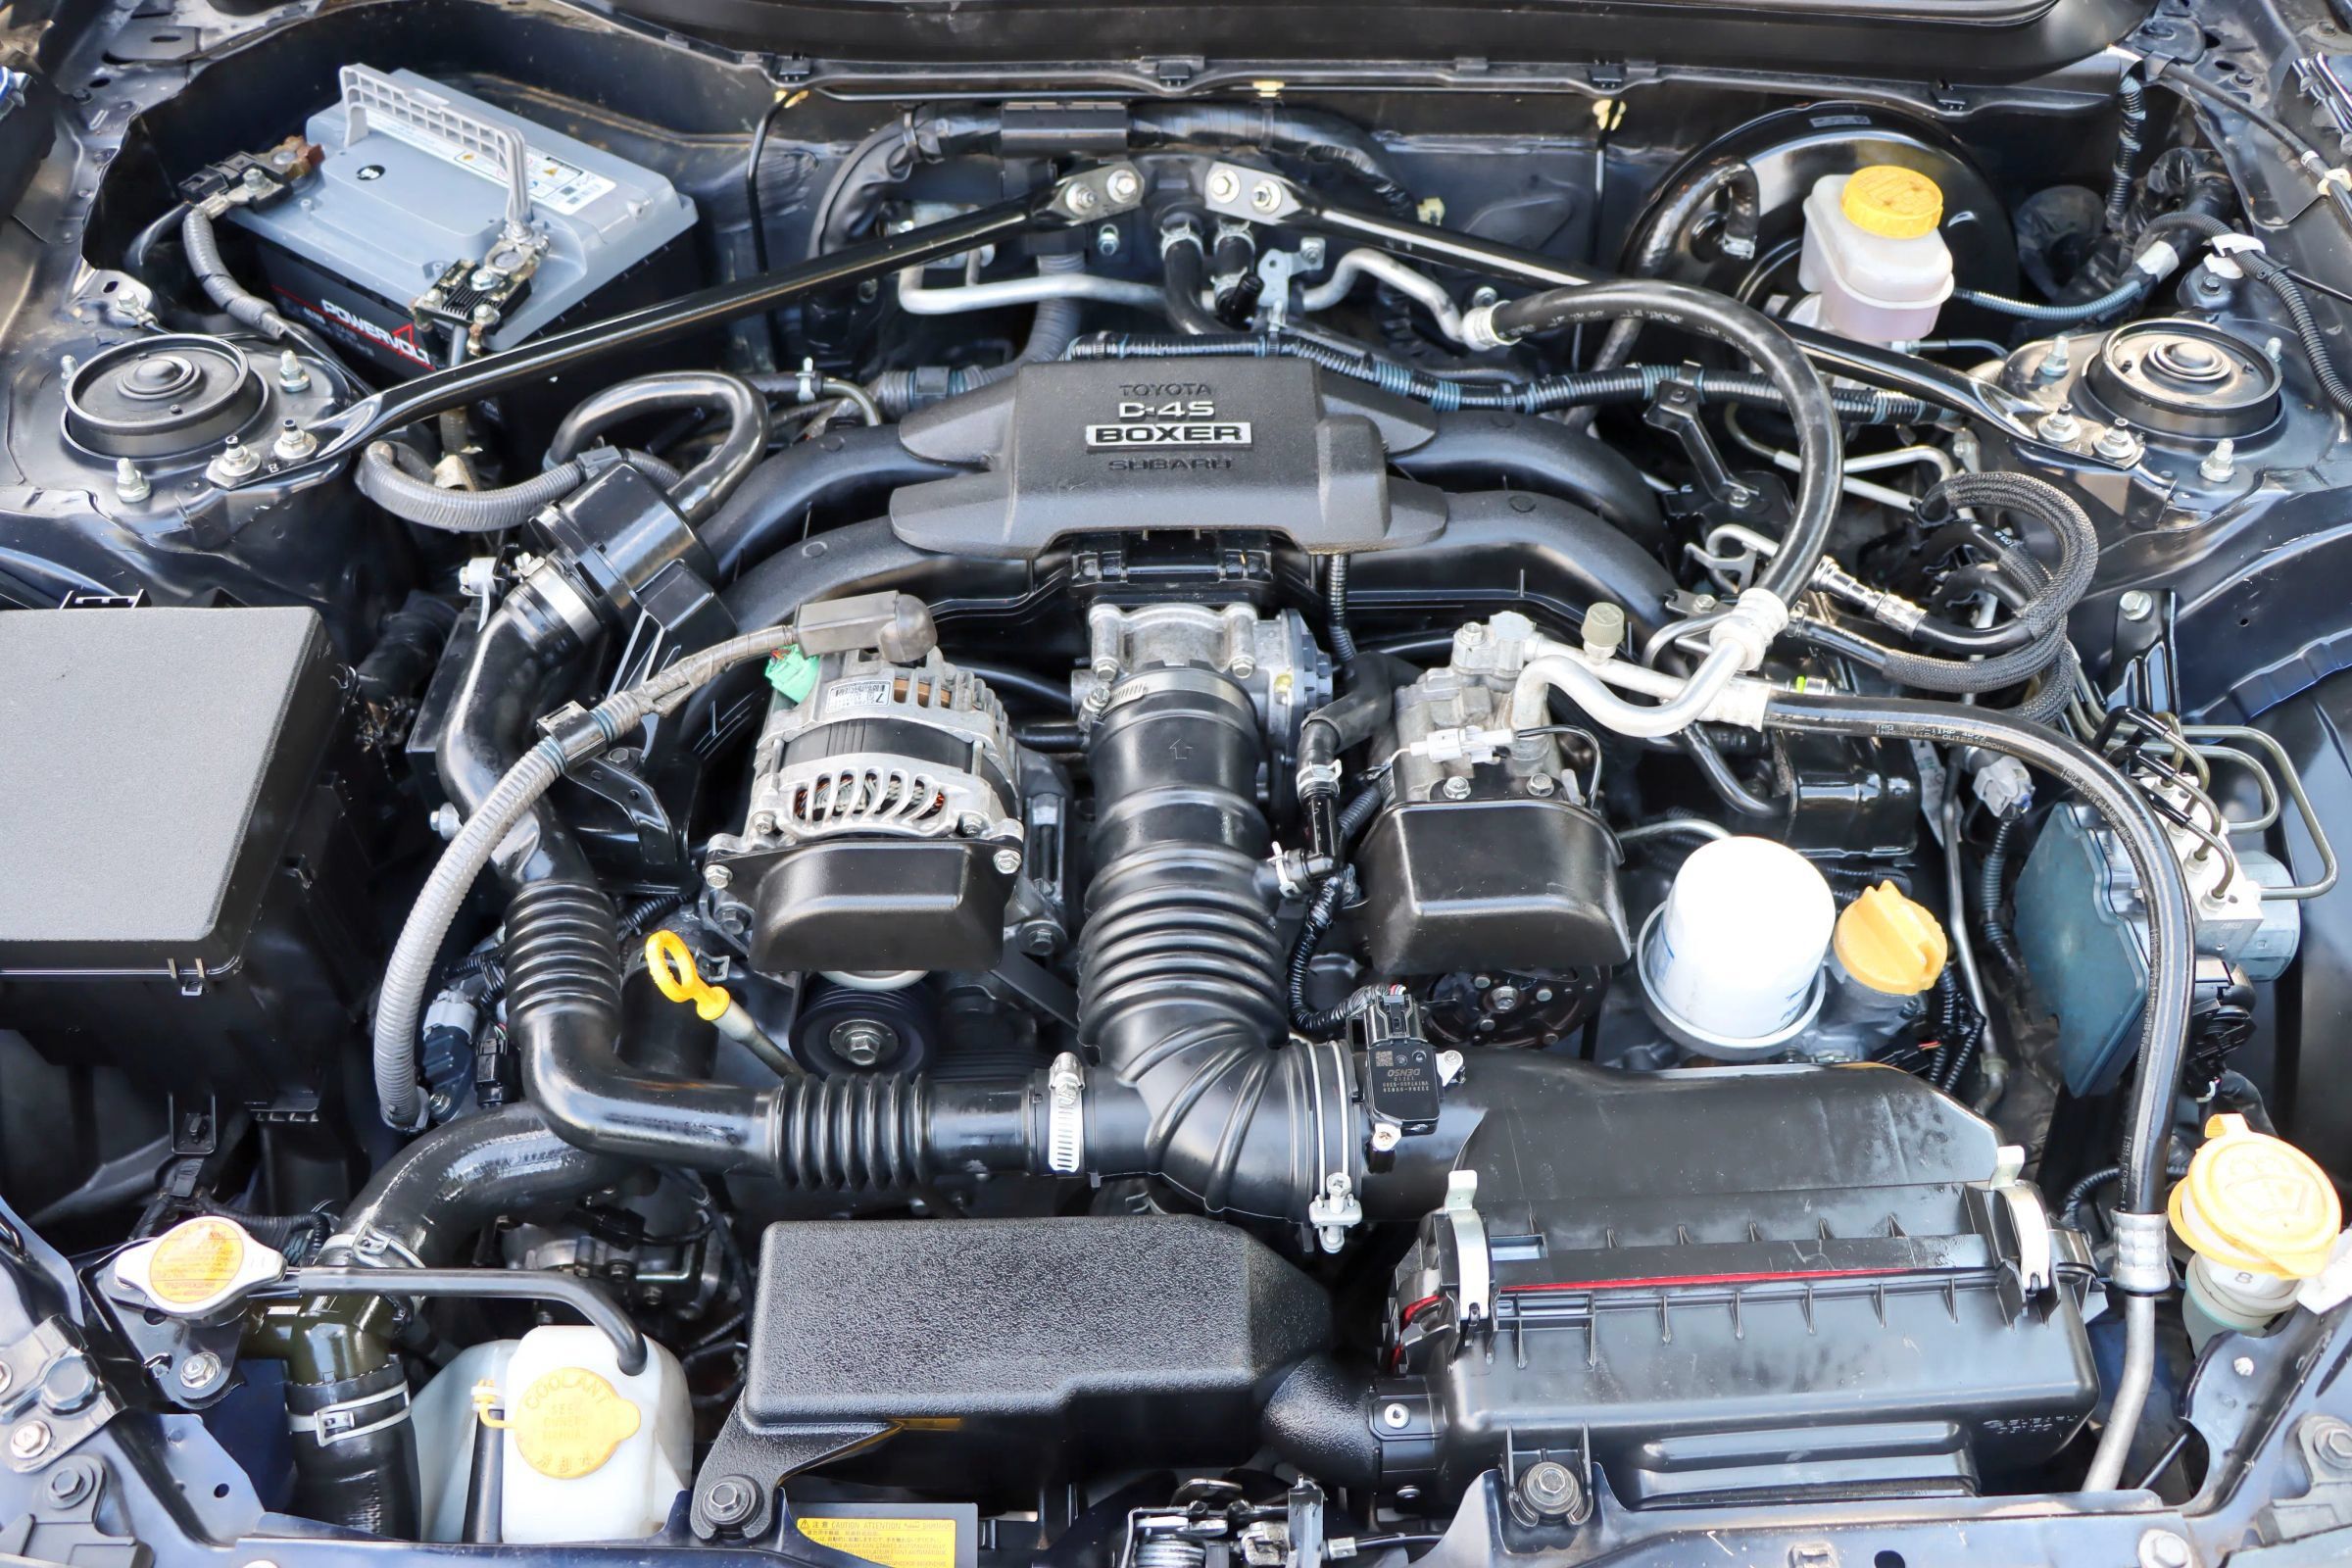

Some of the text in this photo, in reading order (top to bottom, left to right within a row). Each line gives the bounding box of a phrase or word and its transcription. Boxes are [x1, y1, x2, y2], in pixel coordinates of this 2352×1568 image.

[320, 299, 431, 366] POWERVOLT
[1119, 383, 1212, 397] TOYOTA
[1095, 425, 1243, 443] BOXER
[1108, 458, 1233, 471] SUBARU
[1387, 1068, 1421, 1077] DENSO
[523, 1373, 612, 1410] COOLANT
[551, 1402, 573, 1415] SEE
[831, 1521, 860, 1530] CAUTION
[863, 1521, 902, 1530] ATTENTION
